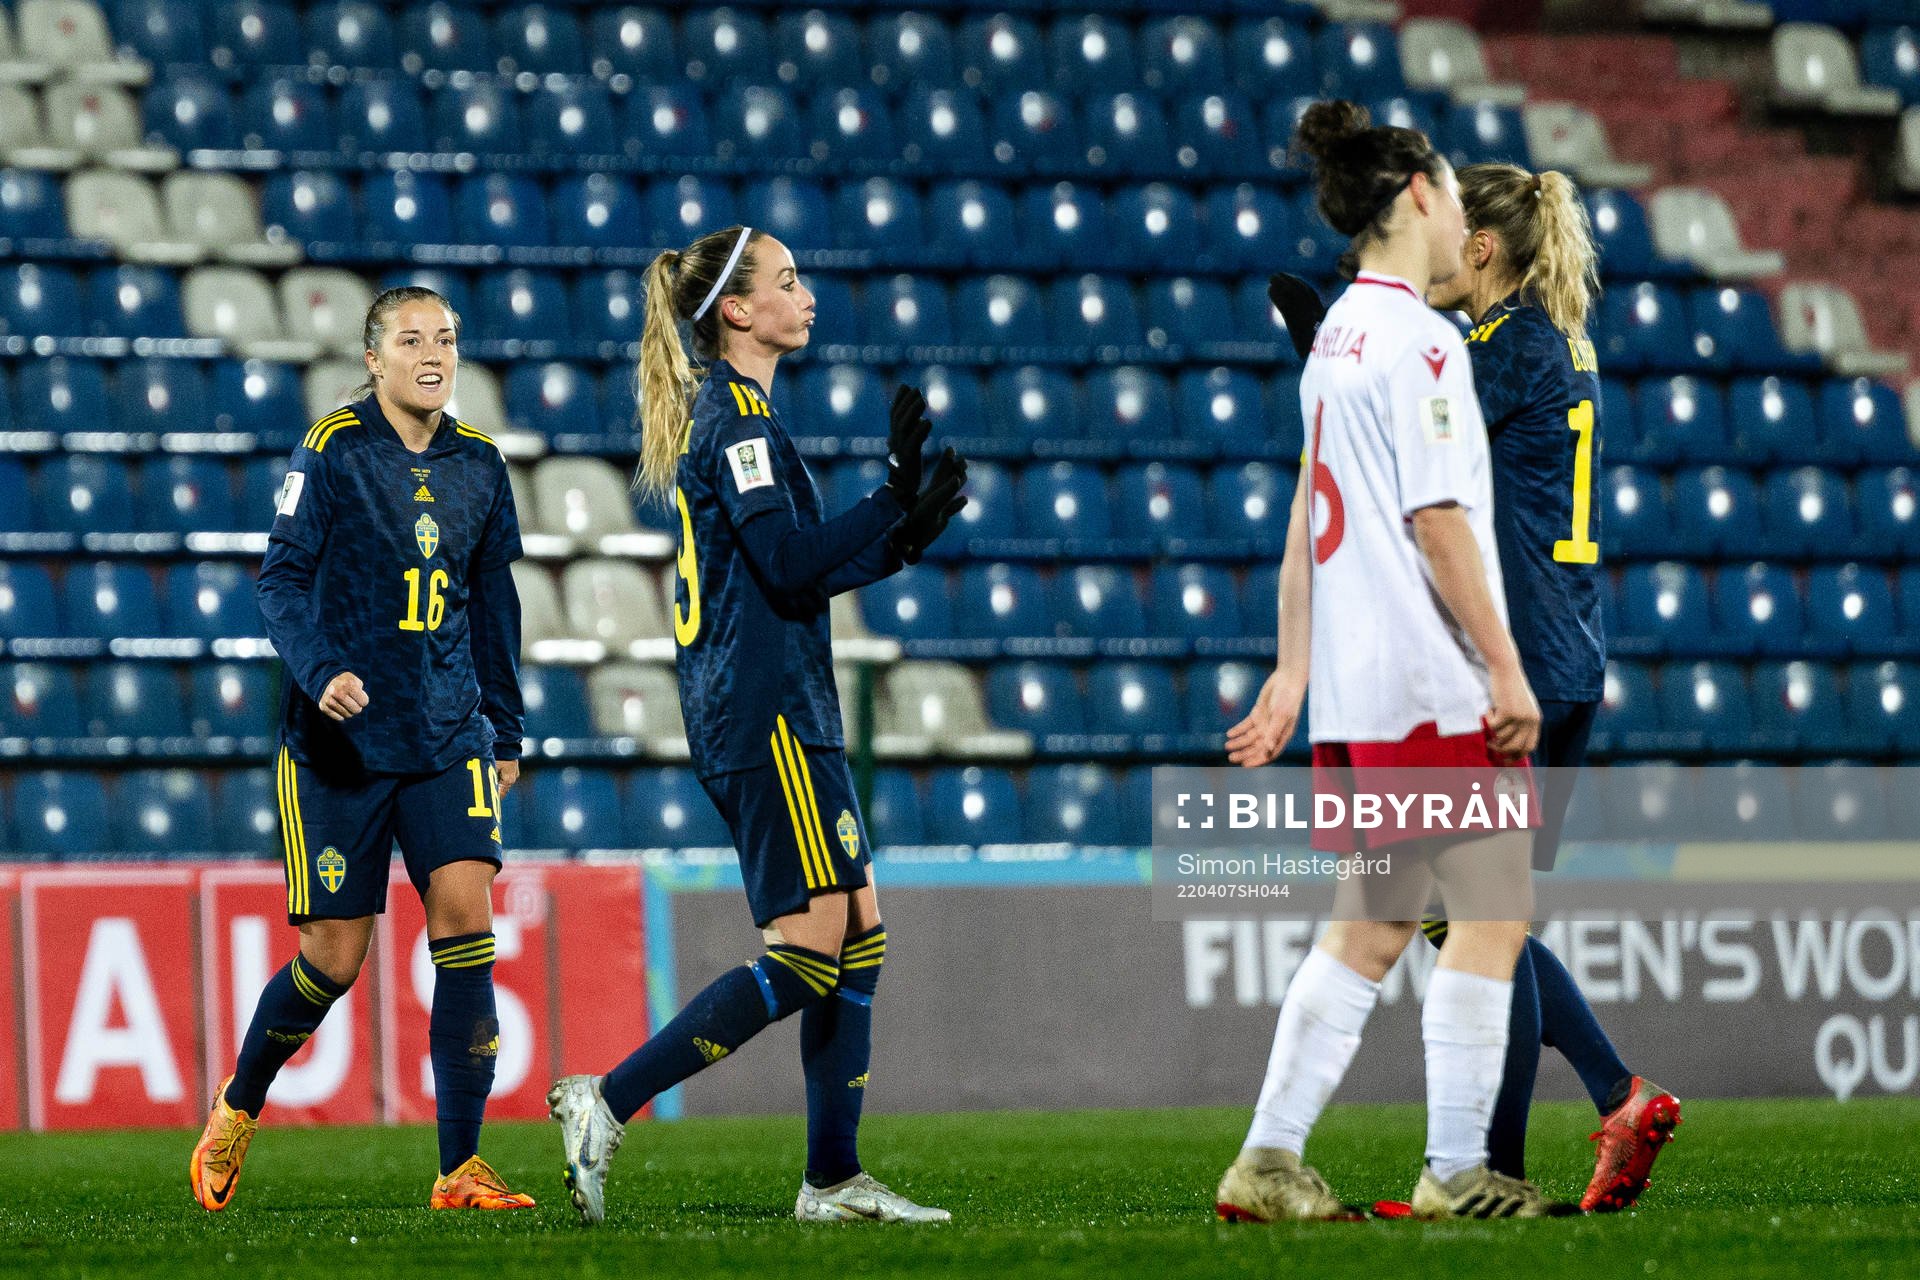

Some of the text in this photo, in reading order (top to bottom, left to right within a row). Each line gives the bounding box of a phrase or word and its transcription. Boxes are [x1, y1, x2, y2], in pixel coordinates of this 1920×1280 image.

[1553, 400, 1599, 564] 1
[399, 568, 448, 631] 16
[466, 758, 502, 823] 16
[1768, 908, 1920, 1002] WO
[1813, 1013, 1920, 1103] QU
